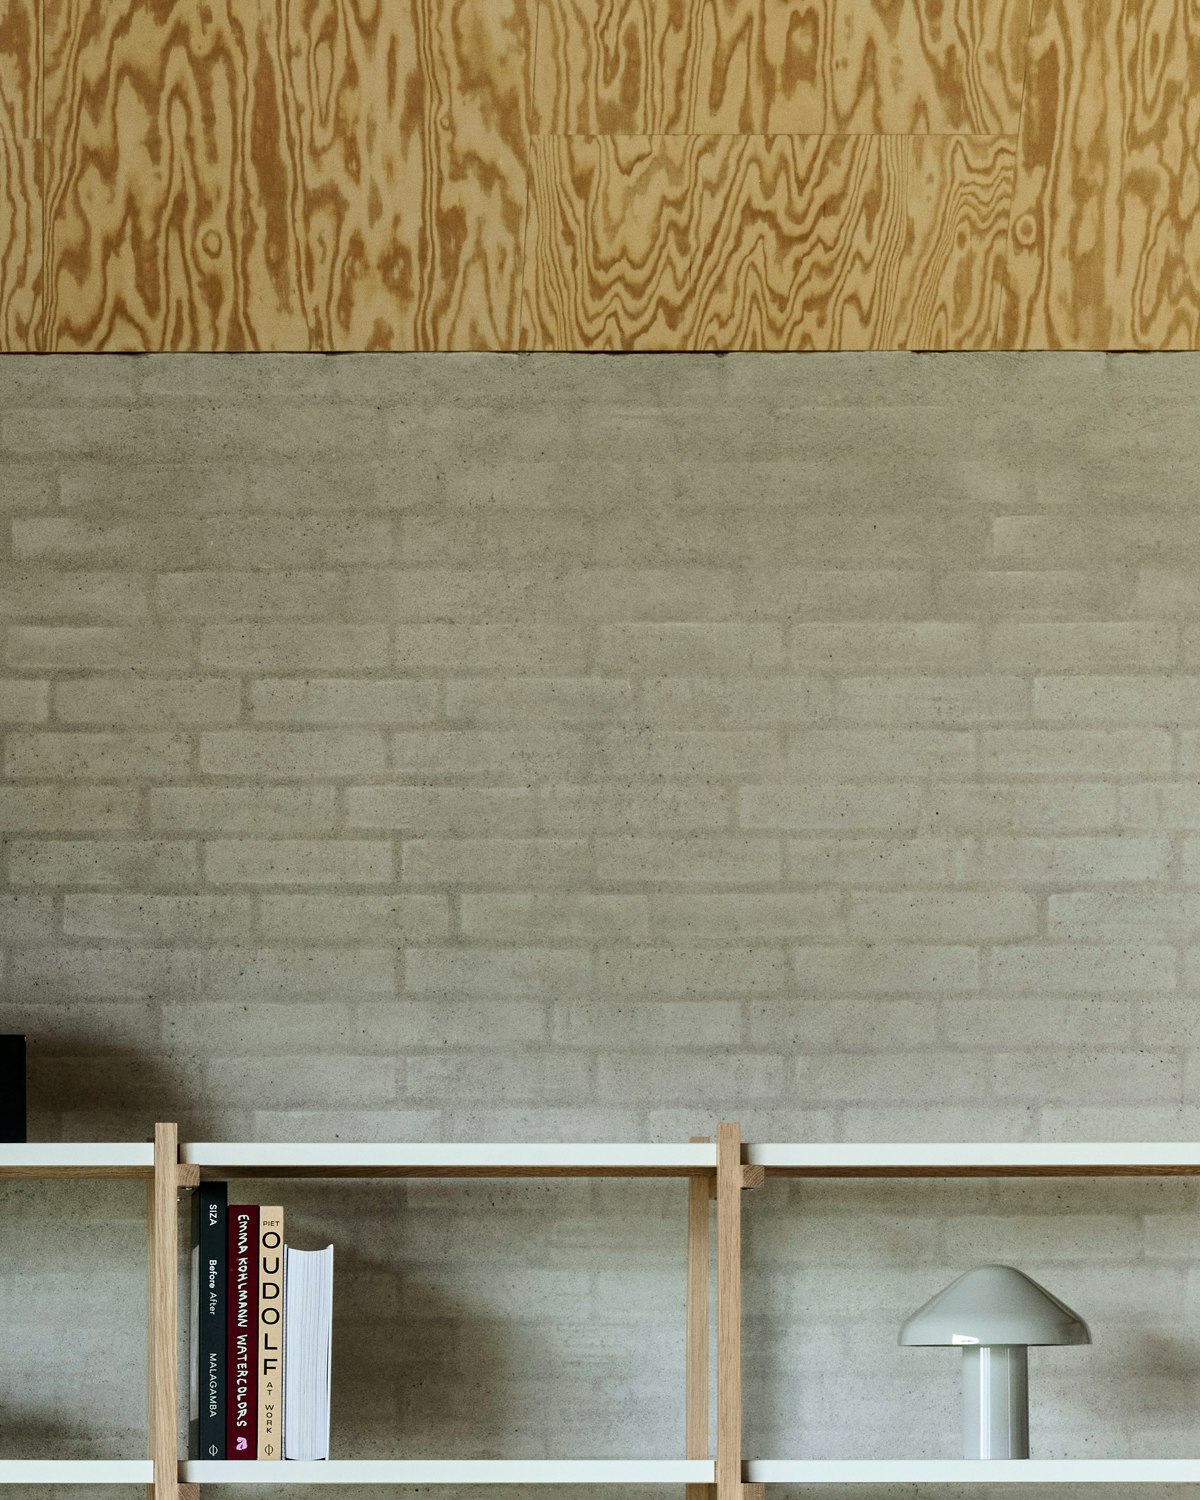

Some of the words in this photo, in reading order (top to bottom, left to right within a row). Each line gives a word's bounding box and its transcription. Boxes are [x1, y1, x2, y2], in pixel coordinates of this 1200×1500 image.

[209, 1204, 217, 1226] SIZA
[237, 1214, 250, 1254] EMMA
[209, 1259, 218, 1289] Before
[209, 1291, 217, 1315] After
[237, 1257, 248, 1328] KOHLMANN
[209, 1353, 217, 1418] MALAGAMBA
[236, 1334, 248, 1427] WATERCOLORS
[266, 1381, 273, 1396] AT
[264, 1404, 275, 1434] WORK
